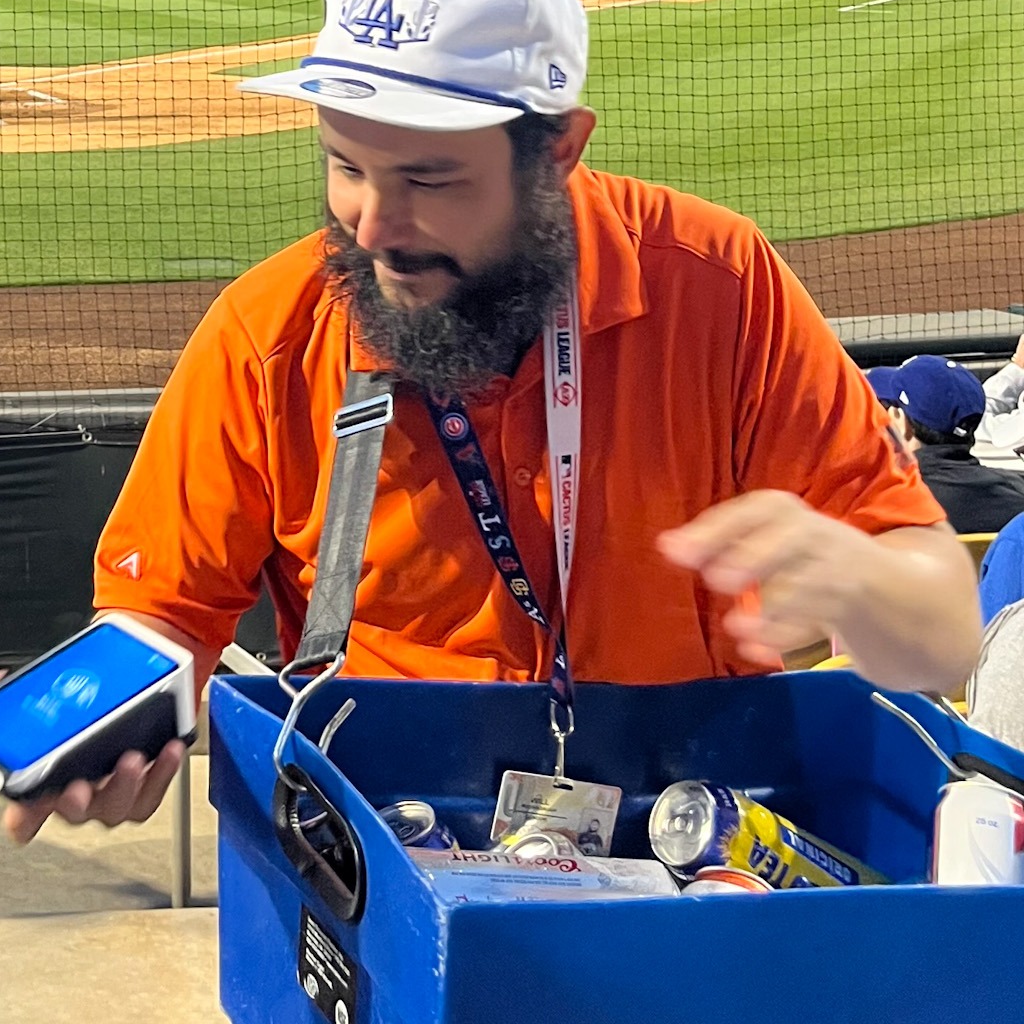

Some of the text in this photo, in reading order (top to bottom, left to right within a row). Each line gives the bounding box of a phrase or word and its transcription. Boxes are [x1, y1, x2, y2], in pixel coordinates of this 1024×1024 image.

[556, 331, 571, 376] LEAGUE
[561, 480, 572, 526] CACTUS
[450, 852, 512, 864] LIGHT
[747, 835, 791, 888] TEA
